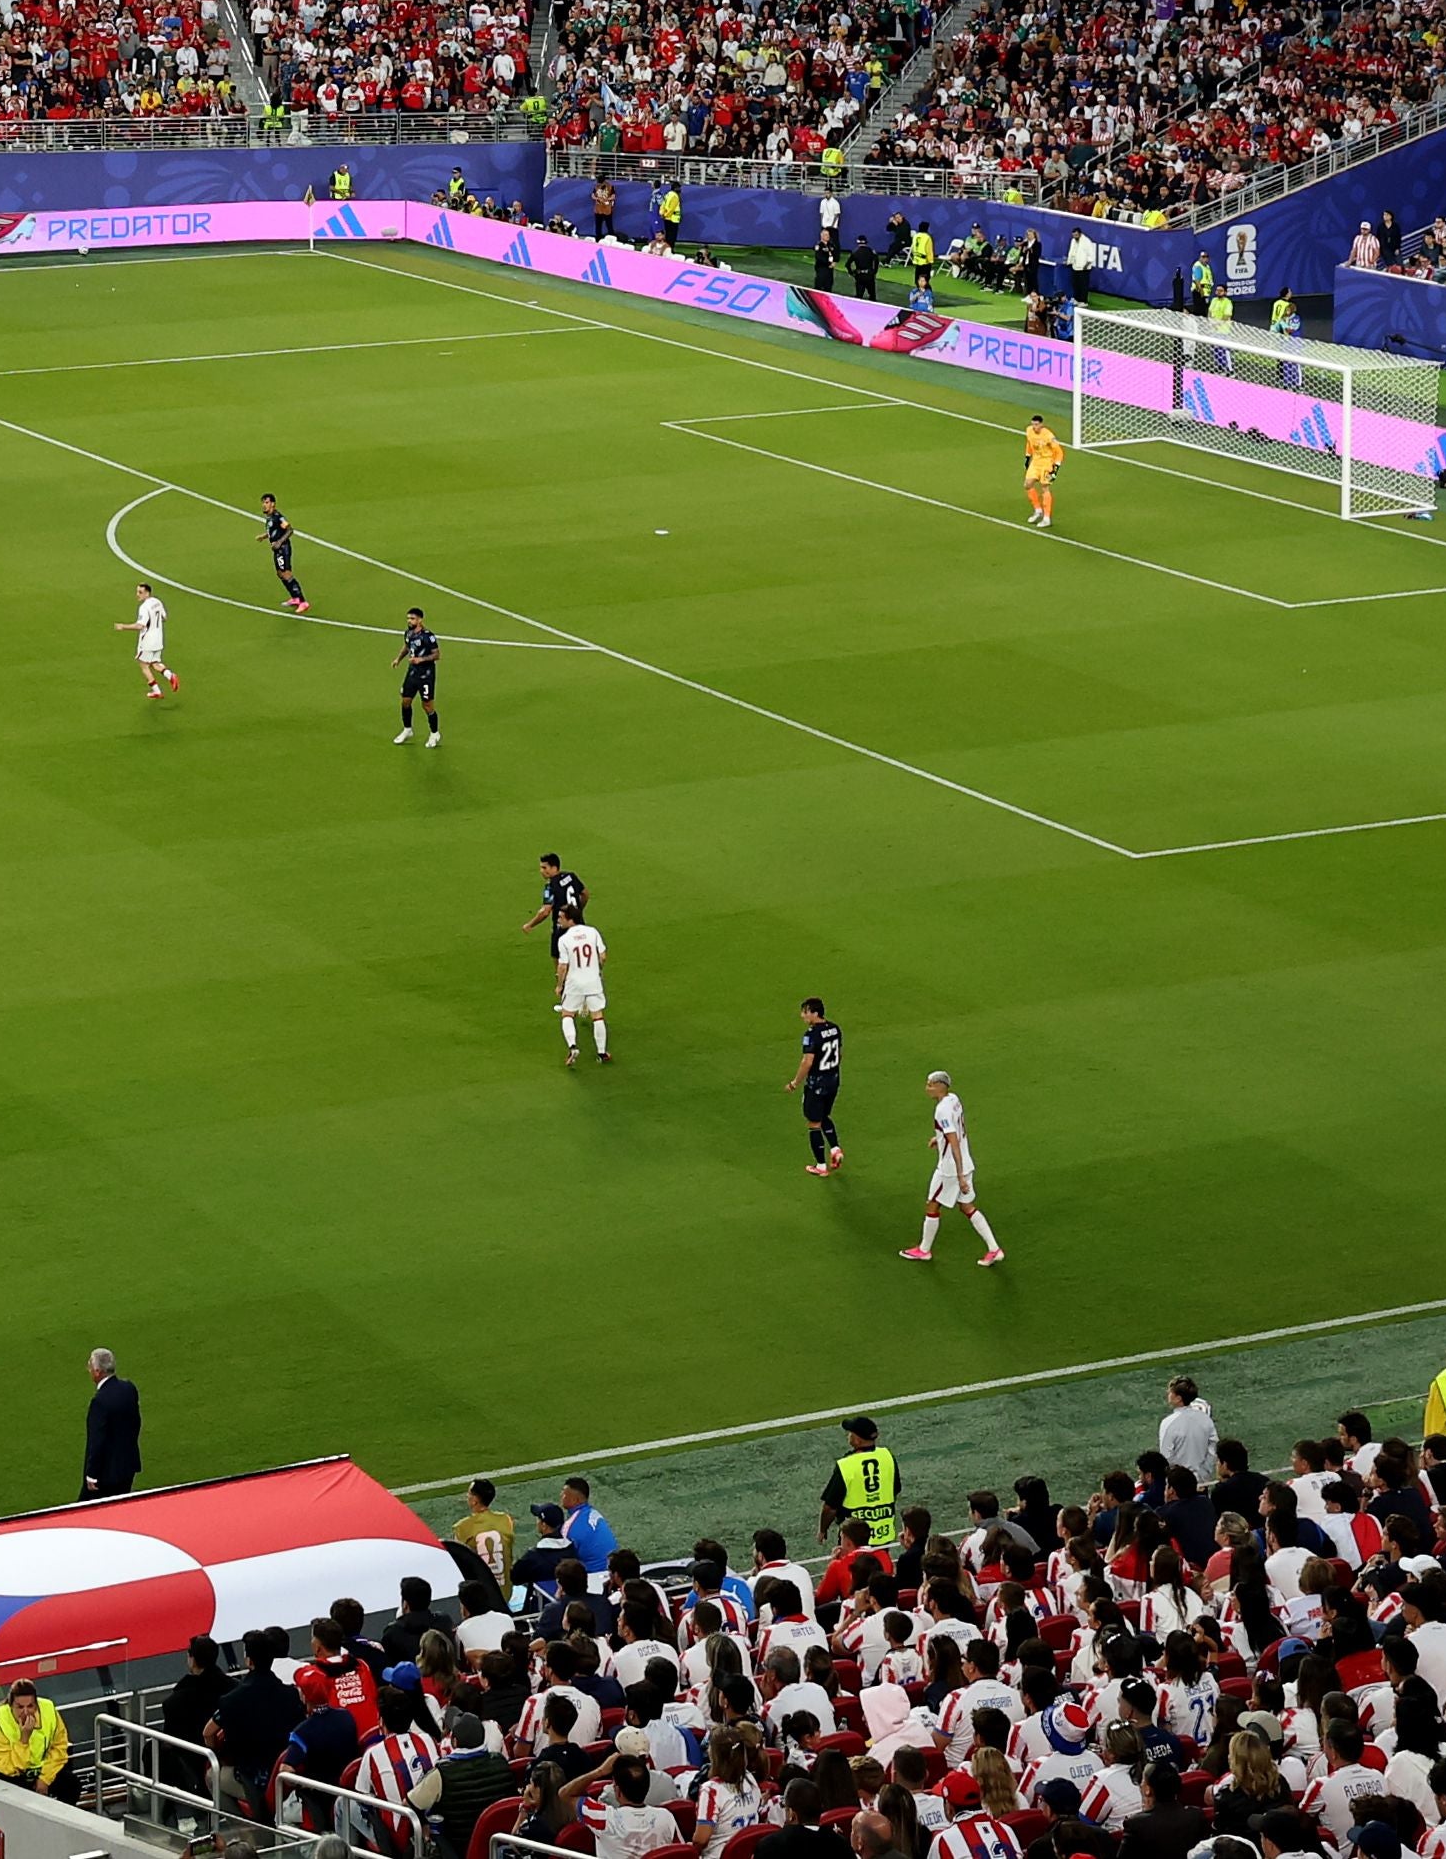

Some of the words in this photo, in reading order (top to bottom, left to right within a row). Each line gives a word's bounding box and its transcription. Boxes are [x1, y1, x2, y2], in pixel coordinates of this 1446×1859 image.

[642, 159, 656, 168] 123
[962, 175, 977, 184] 124
[48, 213, 211, 240] PREDATOR
[1095, 243, 1123, 272] IFA
[668, 269, 771, 312] F50
[1226, 286, 1256, 296] 2026
[566, 885, 578, 908] 6
[573, 944, 592, 968] 19
[819, 1039, 839, 1070] 23
[851, 1507, 892, 1520] SECURITY
[1069, 1765, 1095, 1779] OJEDA
